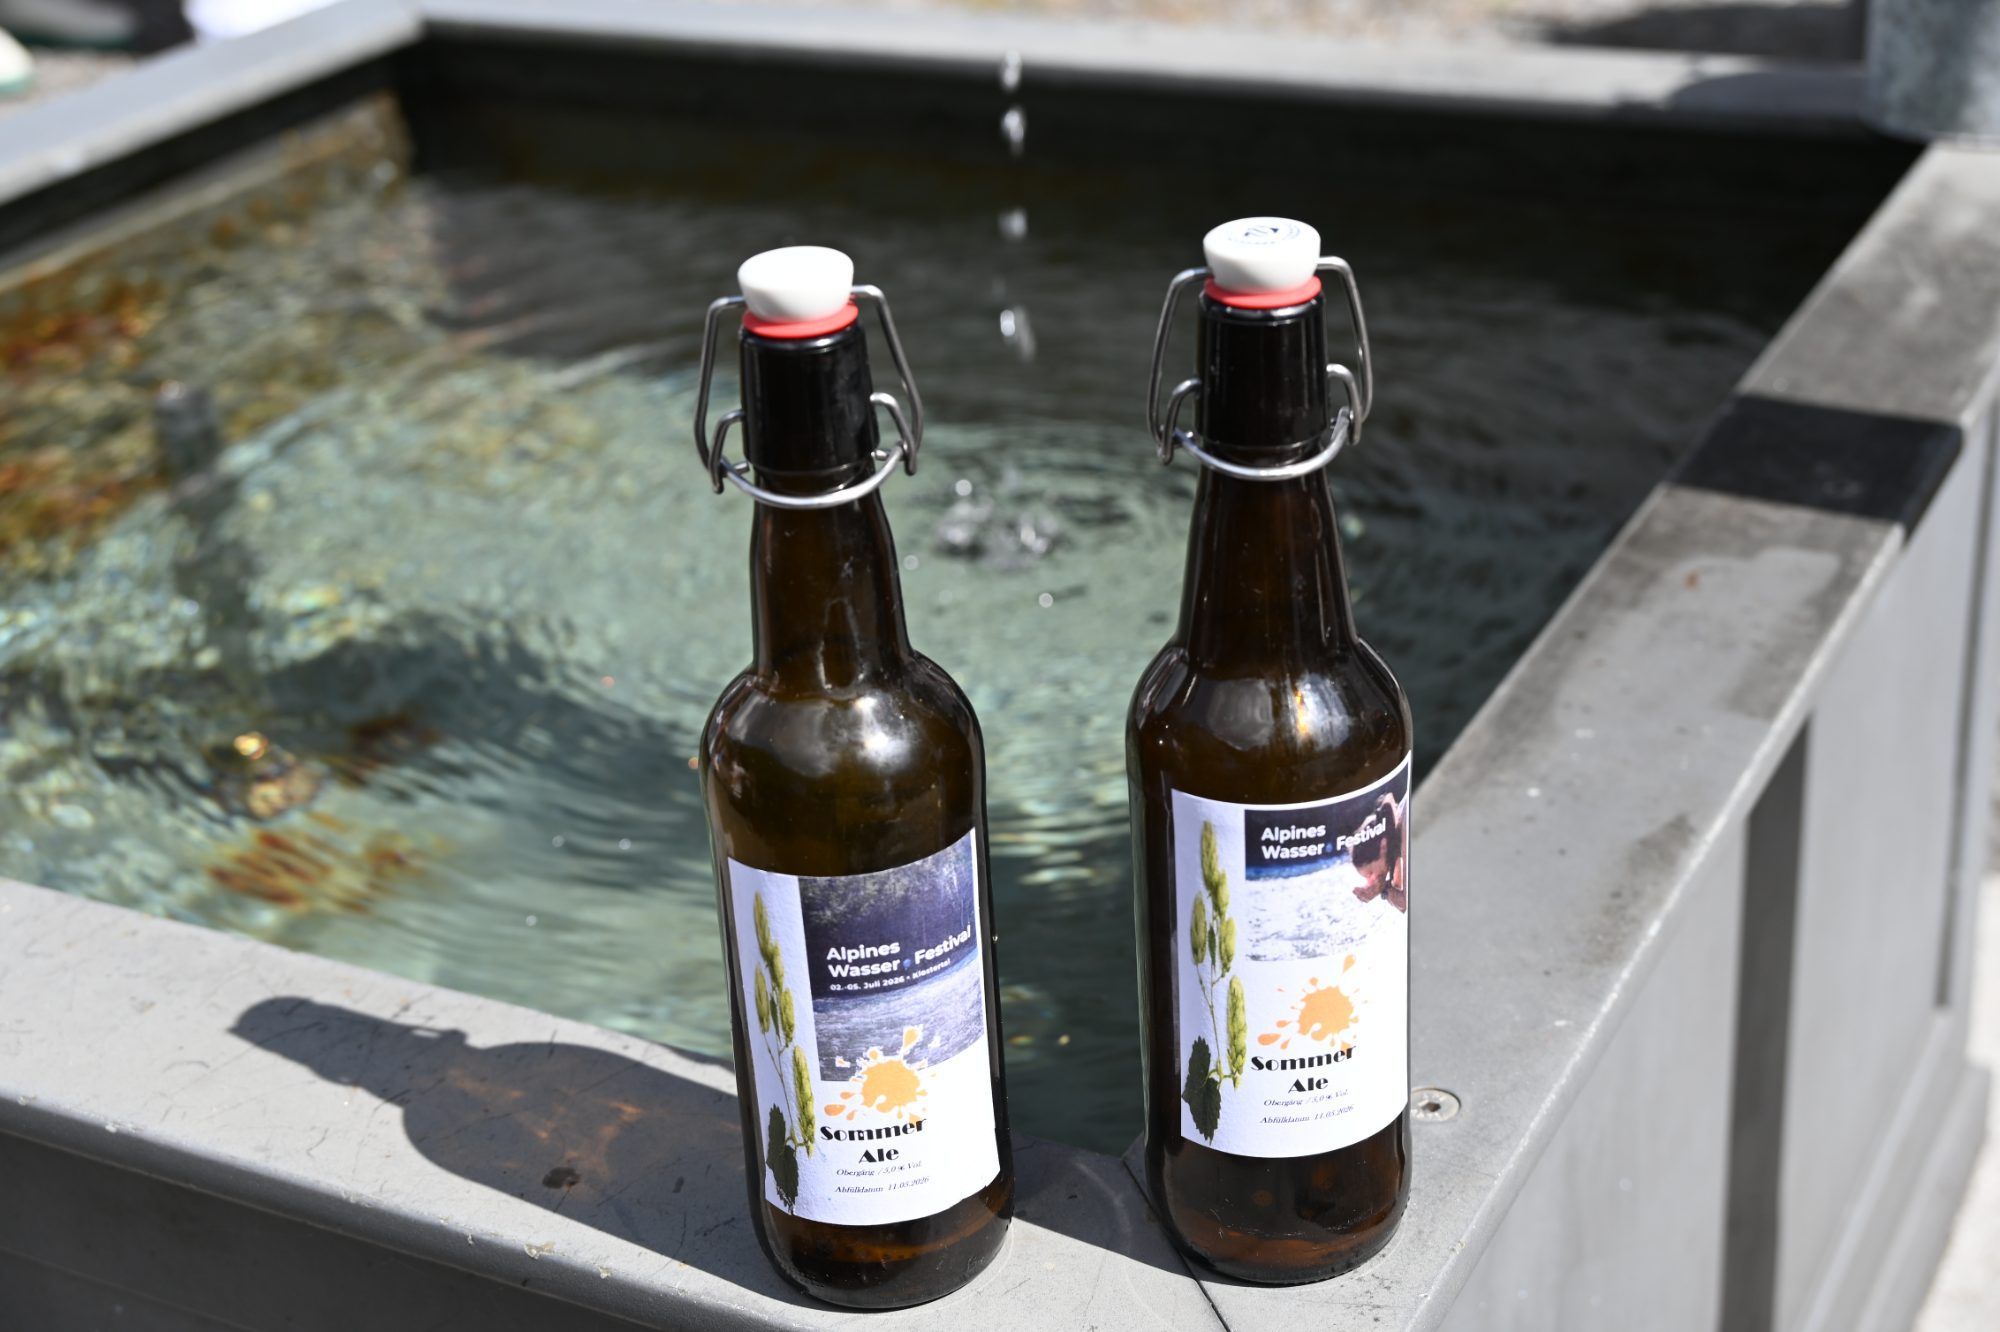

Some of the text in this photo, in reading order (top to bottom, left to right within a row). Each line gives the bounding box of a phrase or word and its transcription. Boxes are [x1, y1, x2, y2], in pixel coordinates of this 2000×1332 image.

[1261, 824, 1326, 844] Alpines
[1262, 817, 1386, 859] Wasser Festival
[826, 942, 900, 963] Alpines
[828, 924, 971, 978] Wasser Festival
[864, 980, 881, 989] Juli
[882, 976, 905, 986] 2026
[912, 958, 951, 979] Klostertal
[1251, 1046, 1356, 1071] Sommer
[1288, 1077, 1329, 1093] Ale
[820, 1118, 927, 1141] Sommer
[858, 1148, 899, 1163] Ale
